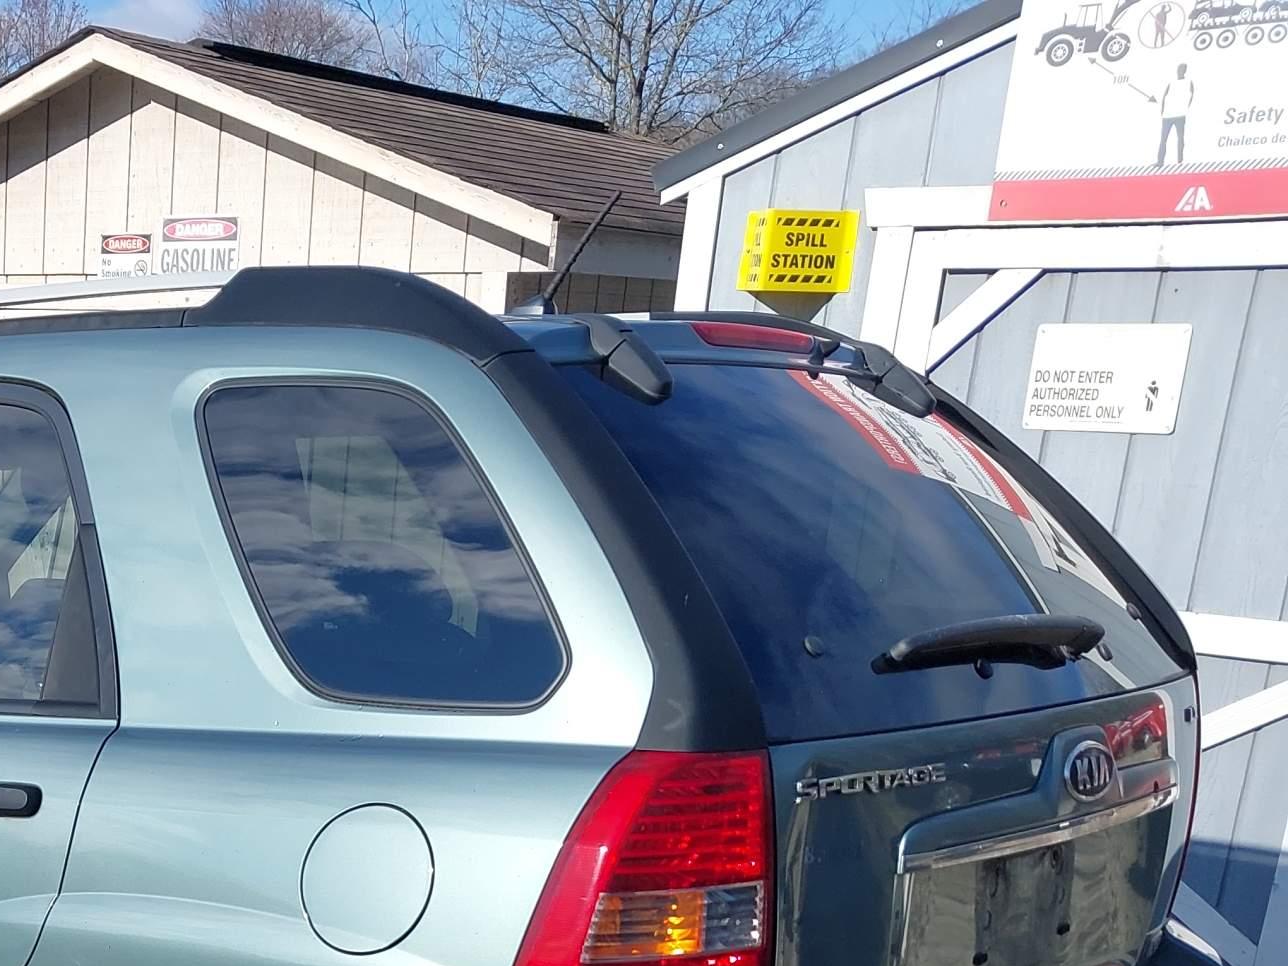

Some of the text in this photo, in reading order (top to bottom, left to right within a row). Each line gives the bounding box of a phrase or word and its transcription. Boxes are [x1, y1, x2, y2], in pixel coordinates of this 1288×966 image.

[1223, 106, 1285, 125] Safety
[1217, 135, 1268, 148] Chaleco
[108, 238, 143, 250] DANGER
[785, 232, 828, 248] SPILL
[102, 258, 111, 267] No
[161, 248, 236, 273] GASOLINE
[771, 253, 836, 269] STATION
[1034, 370, 1114, 384] DO NOT ENTER
[1031, 387, 1100, 401] AUTHORIZED
[1029, 404, 1125, 419] PERSONNEL ONLY
[1074, 755, 1111, 791] KIA
[795, 762, 948, 805] SPORTAGE
